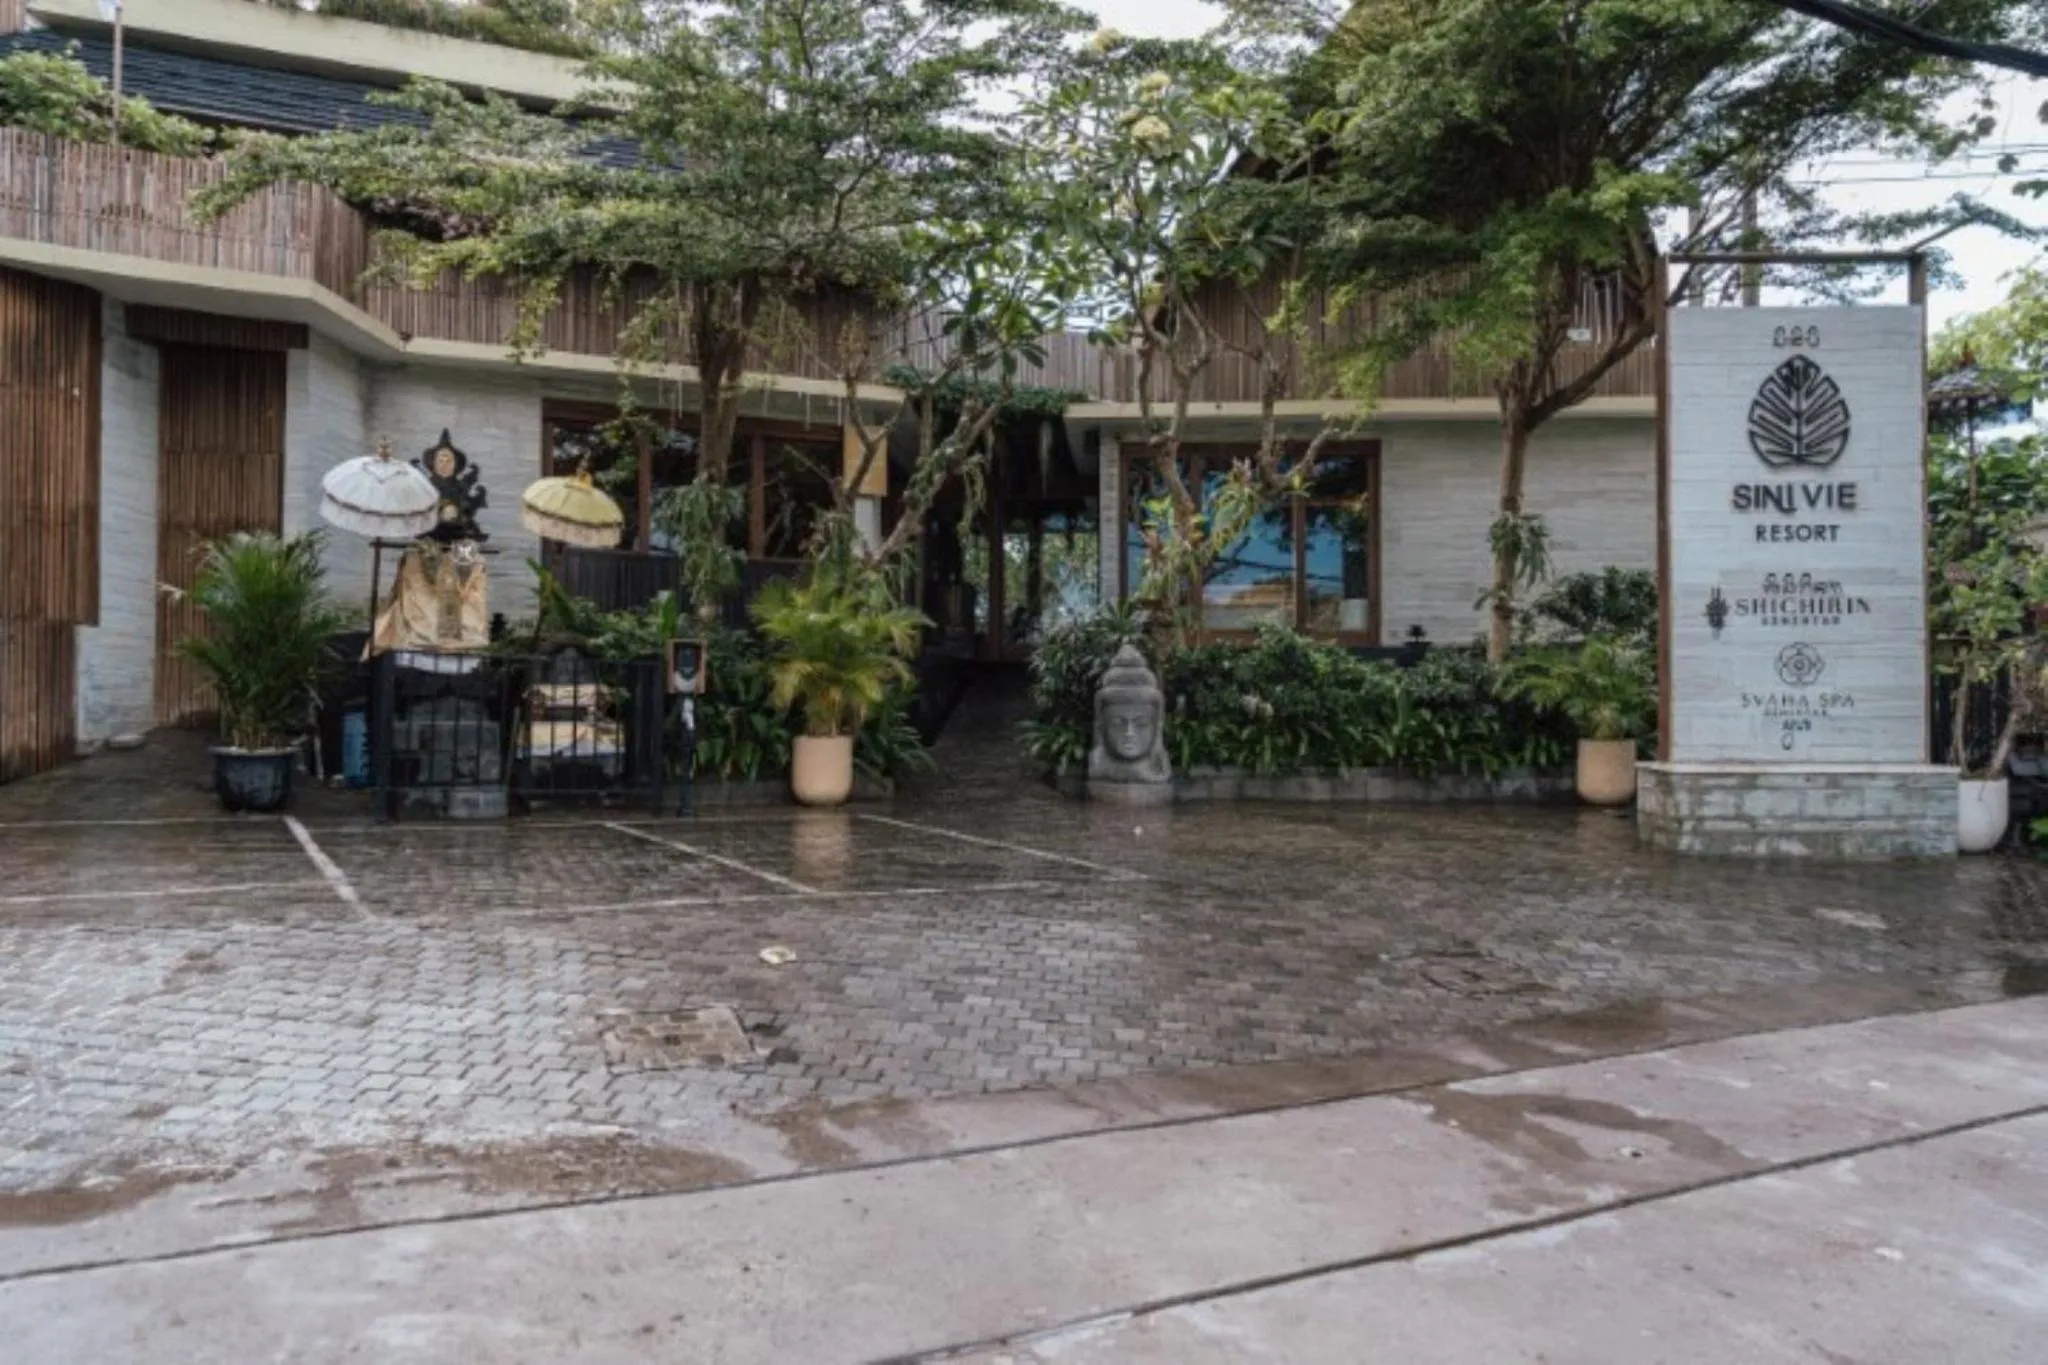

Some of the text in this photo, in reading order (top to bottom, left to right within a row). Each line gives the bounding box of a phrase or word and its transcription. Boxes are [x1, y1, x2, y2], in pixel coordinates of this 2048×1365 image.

[1732, 482, 1857, 514] SINI VIE
[1755, 524, 1840, 542] RESORT
[1735, 597, 1871, 615] SHICHIRIN
[1819, 692, 1855, 708] SPA
